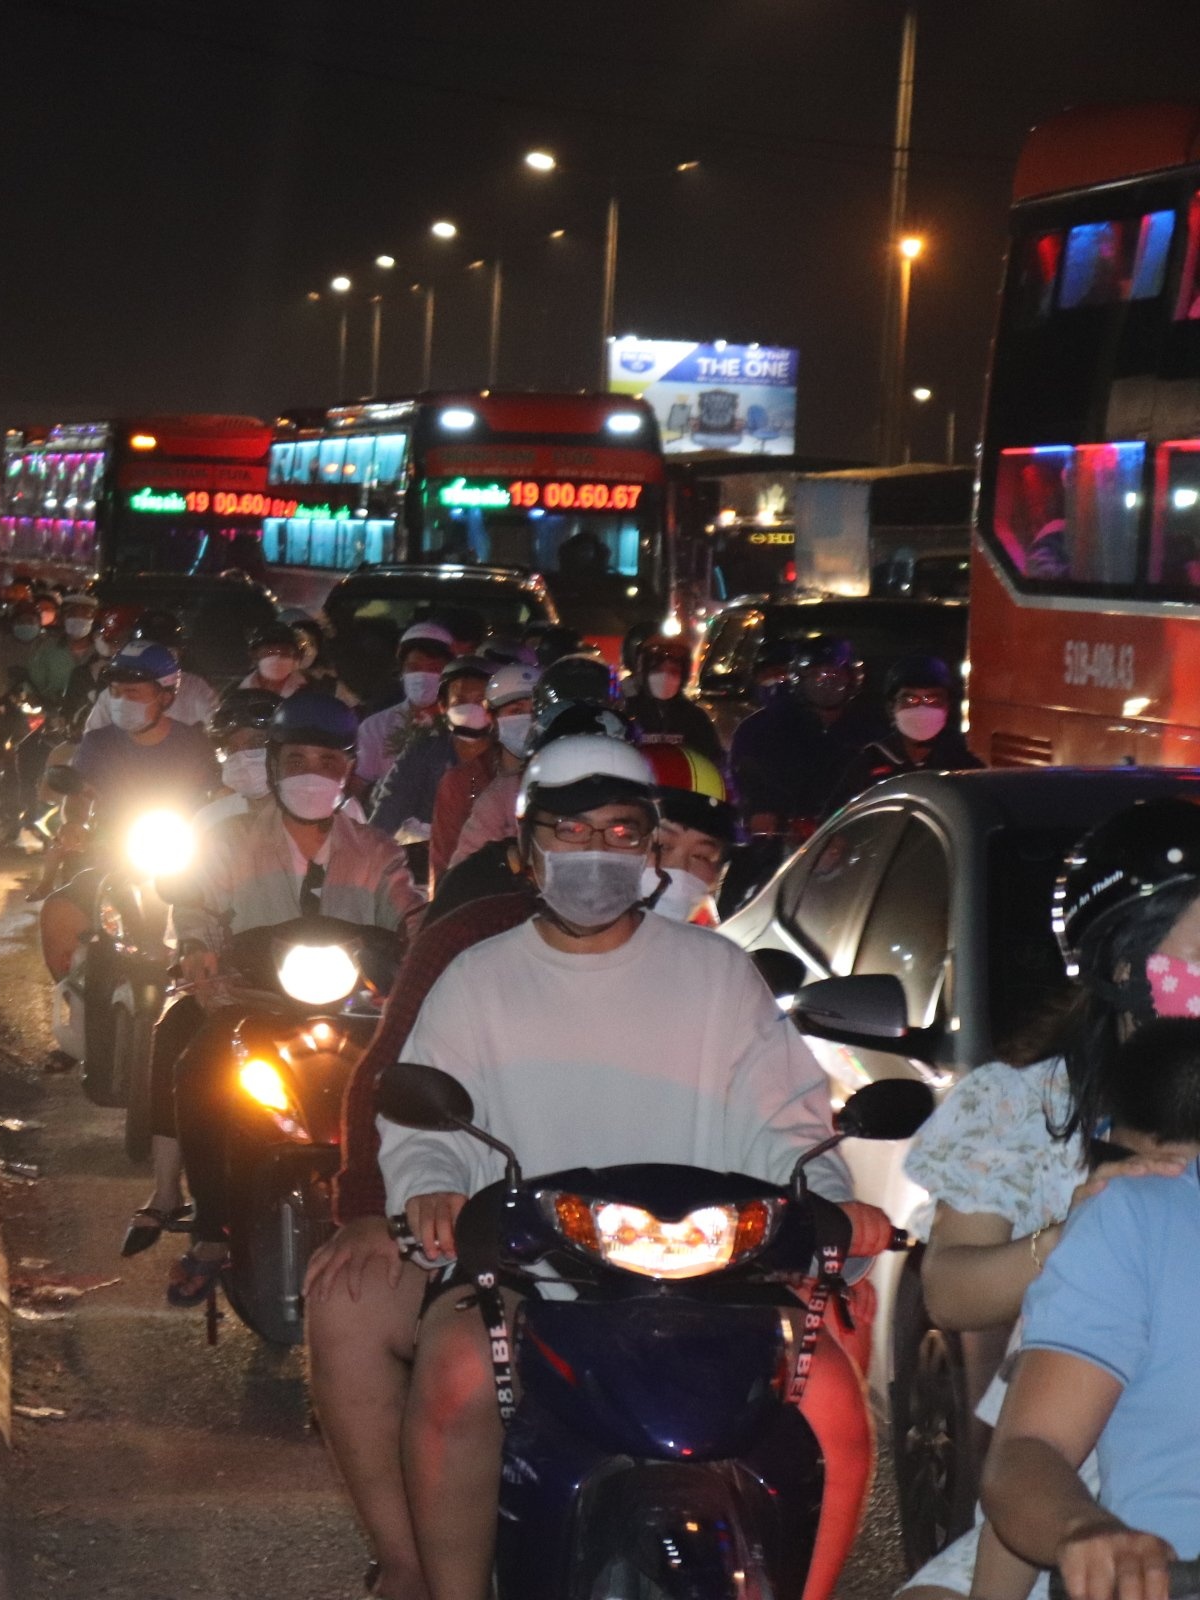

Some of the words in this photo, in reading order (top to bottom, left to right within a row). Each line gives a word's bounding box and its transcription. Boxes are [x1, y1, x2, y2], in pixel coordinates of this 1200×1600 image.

[697, 357, 740, 377] THE
[745, 359, 789, 378] ONE
[186, 491, 209, 513] 19
[213, 492, 265, 515] 00.60
[510, 481, 539, 506] 19
[544, 482, 642, 510] 00.60.67
